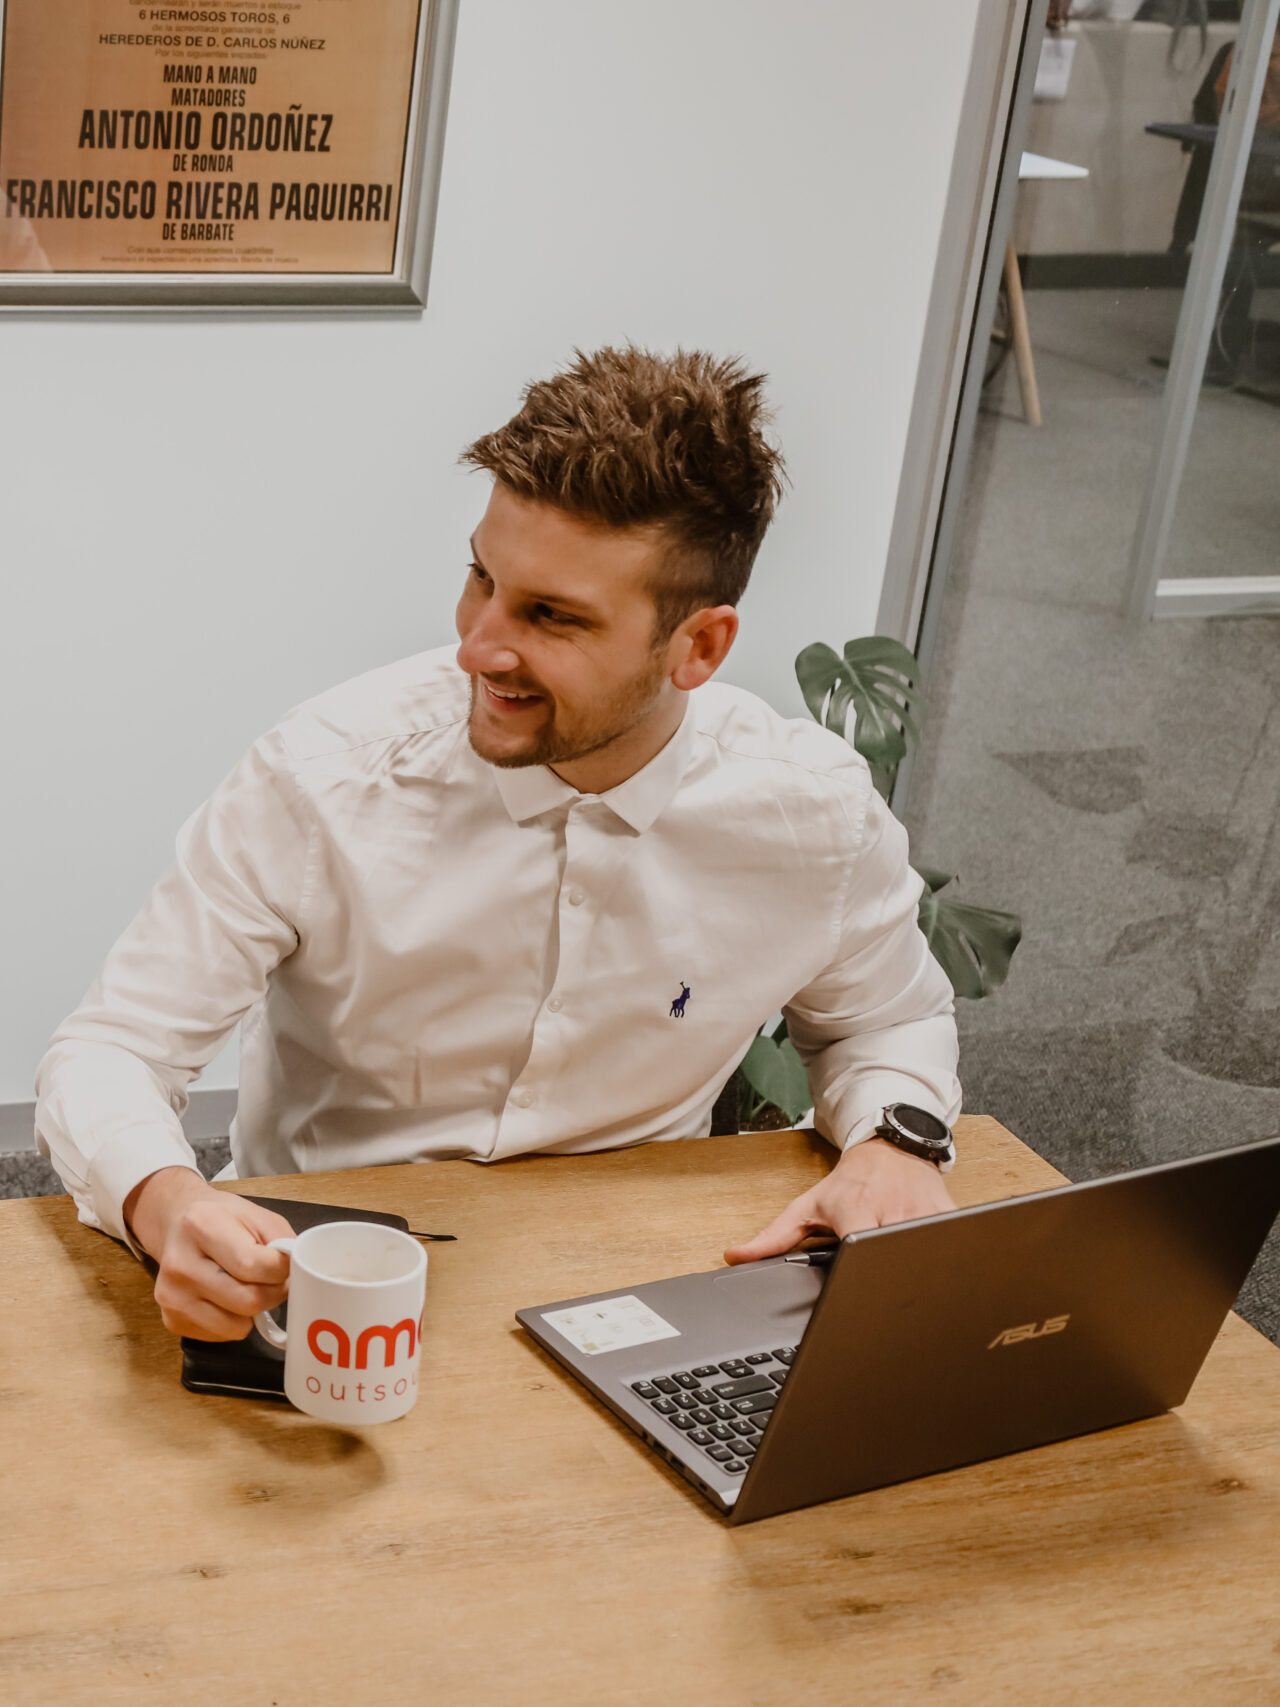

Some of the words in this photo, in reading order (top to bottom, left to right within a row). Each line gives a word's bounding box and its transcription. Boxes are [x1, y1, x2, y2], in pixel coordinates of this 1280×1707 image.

[139, 9, 146, 20] 6
[150, 10, 226, 22] HERMOSOS
[230, 11, 279, 25] TOROS,
[282, 13, 290, 24] 6
[99, 33, 181, 47] HEREDEROS
[185, 35, 203, 47] DE
[207, 36, 220, 48] D.
[223, 36, 277, 49] CARLOS
[163, 64, 202, 84] MANO
[206, 65, 215, 84] A
[218, 65, 257, 85] MANO
[171, 87, 246, 107] MATADORES
[78, 109, 202, 150] ANTONIO
[210, 103, 334, 153] ORDOÑEZ
[172, 153, 188, 172] DE
[191, 154, 234, 173] RONDA
[5, 178, 157, 220] FRANCISCO
[166, 180, 259, 220] RIVERA
[269, 182, 393, 222] PAQUIRRI
[162, 223, 177, 240] DE
[181, 223, 235, 241] BARBATE
[307, 1308, 424, 1370] am
[987, 1313, 1071, 1350] ASUS
